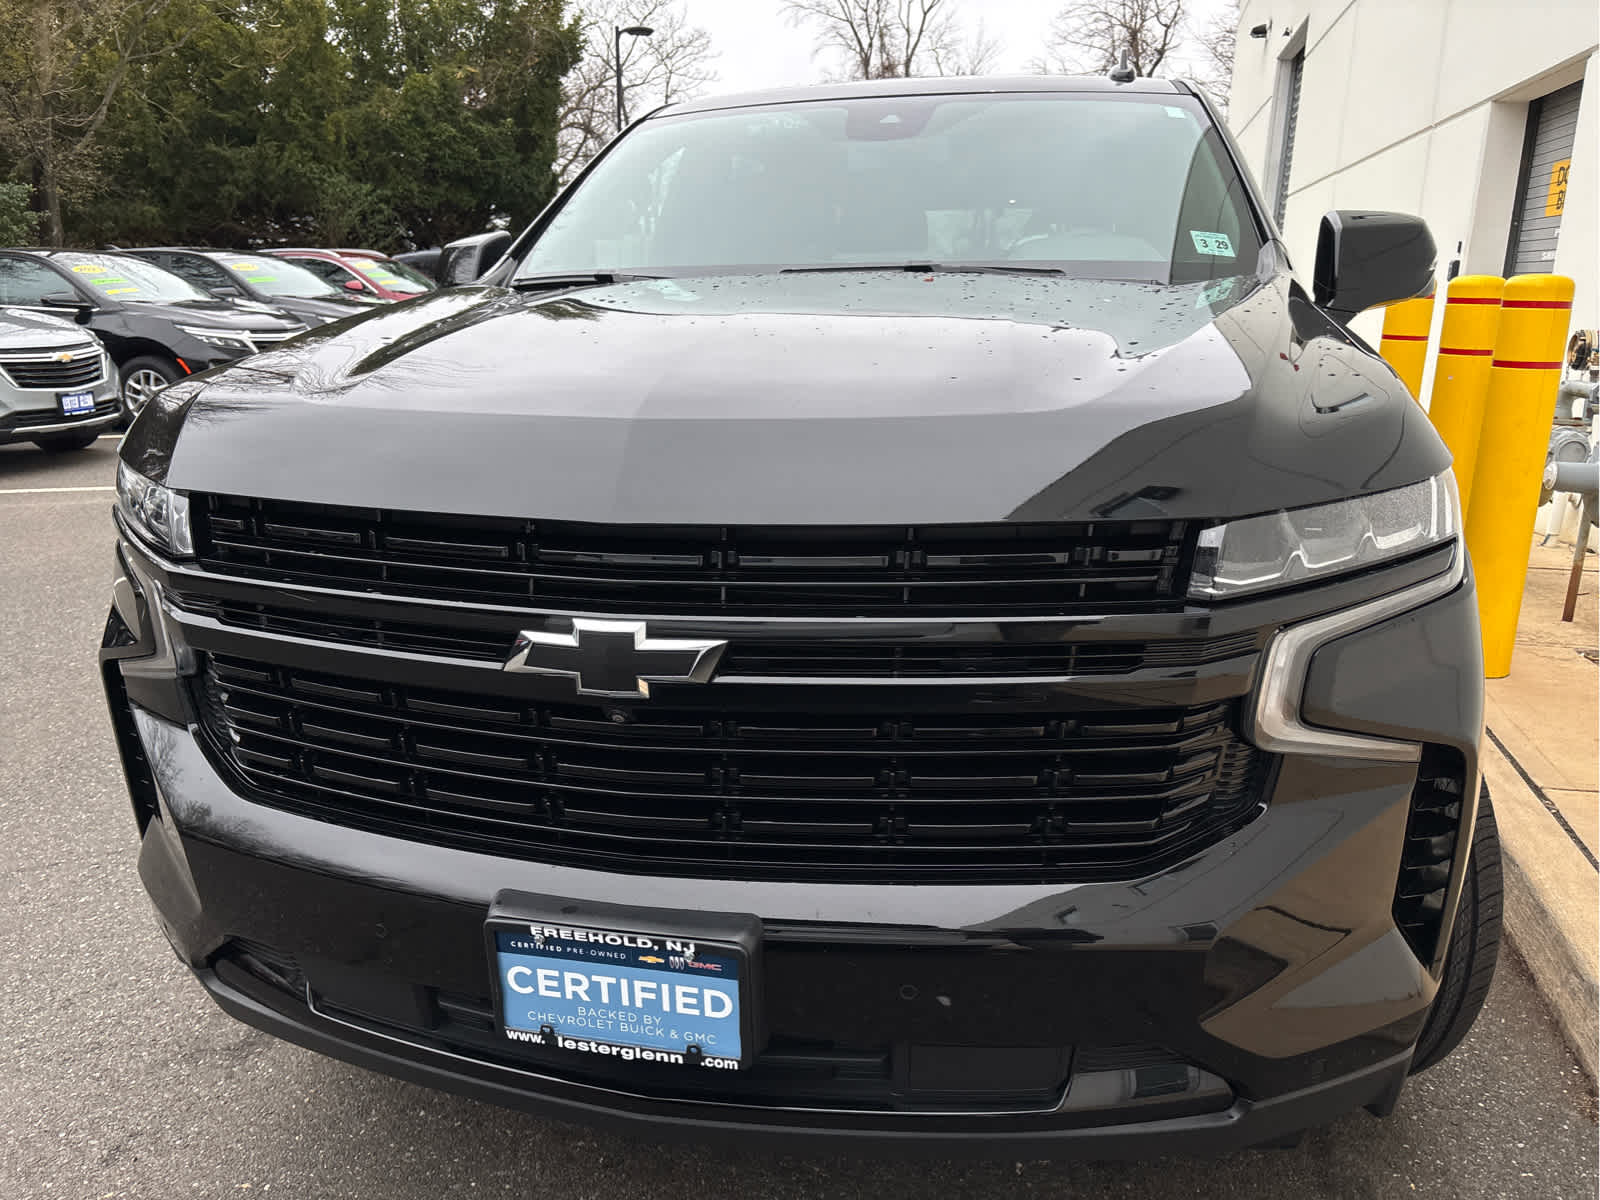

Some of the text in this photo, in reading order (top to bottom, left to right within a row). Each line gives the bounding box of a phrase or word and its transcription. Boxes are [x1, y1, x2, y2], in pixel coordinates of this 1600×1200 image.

[1200, 239, 1229, 250] 3 29
[510, 941, 627, 959] CERTIFIED PRE-OWNED
[507, 965, 733, 1018] CERTIFIED
[527, 1010, 717, 1045] CHEVROLET BUICK & GMC
[577, 1006, 662, 1026] BACKED BY
[506, 1029, 738, 1070] www. lesterglenn .com
